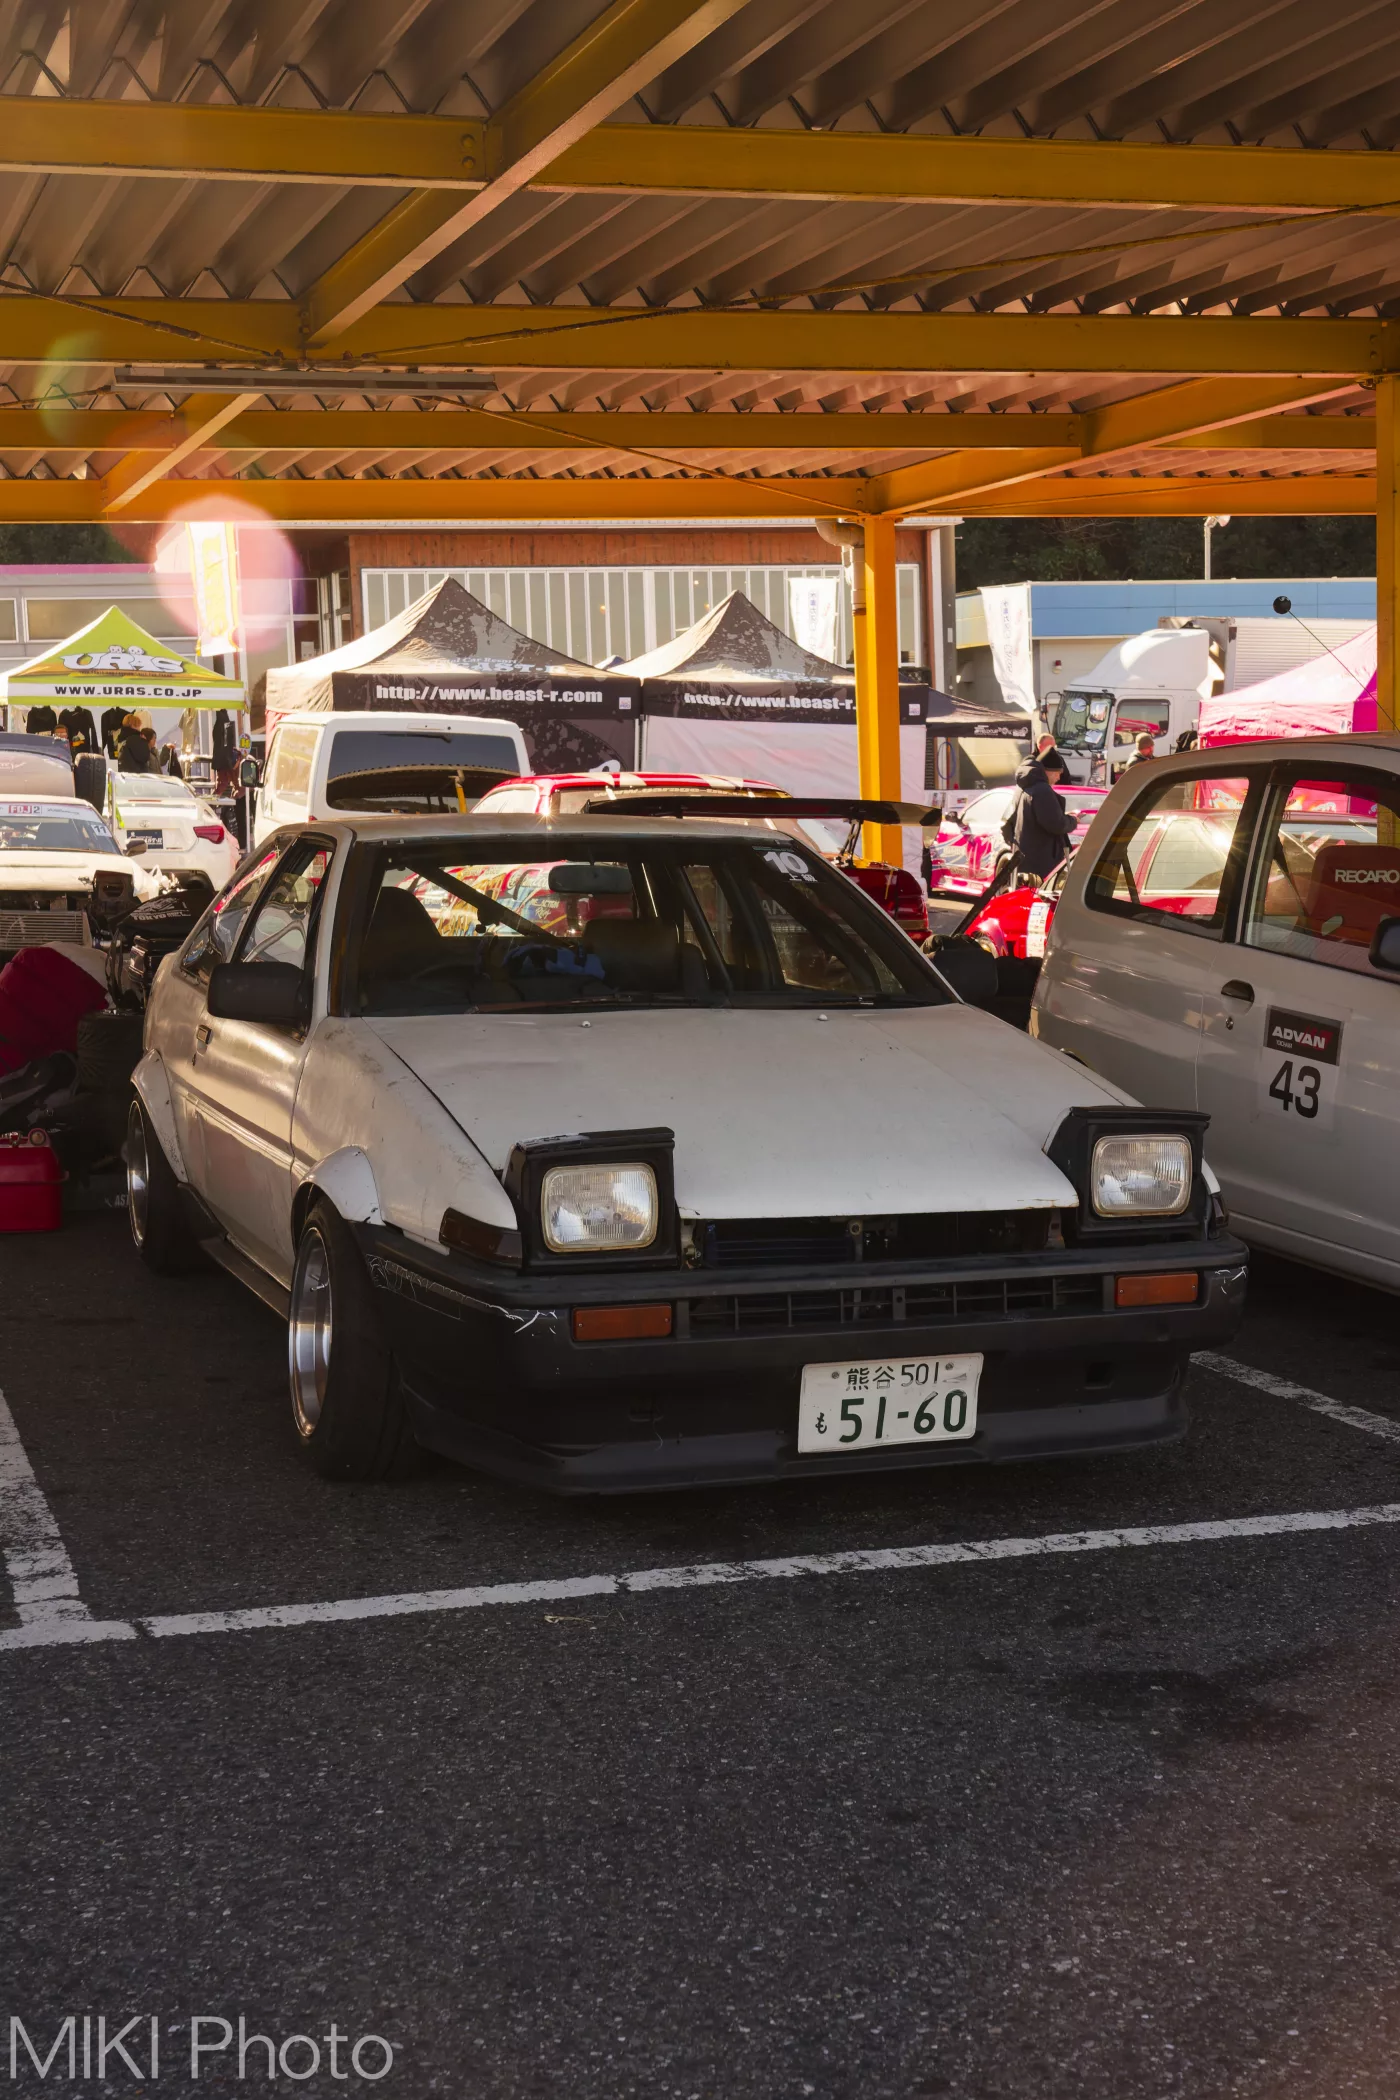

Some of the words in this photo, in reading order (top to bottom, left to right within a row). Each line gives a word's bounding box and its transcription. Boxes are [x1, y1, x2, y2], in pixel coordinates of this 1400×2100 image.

[60, 651, 186, 673] URAS
[54, 686, 202, 698] WWW.URAS.CO.JP
[376, 685, 603, 703] http://www.beast-r.com
[684, 692, 856, 710] http://www.beast-r.
[93, 825, 107, 835] 11
[763, 851, 809, 874] 10
[1335, 869, 1400, 884] RECARO
[1271, 1025, 1326, 1049] ADVAN
[1268, 1059, 1321, 1119] 43
[845, 1365, 896, 1391] 熊谷
[900, 1361, 940, 1387] 501
[814, 1412, 828, 1435] も
[838, 1388, 968, 1443] 51-60
